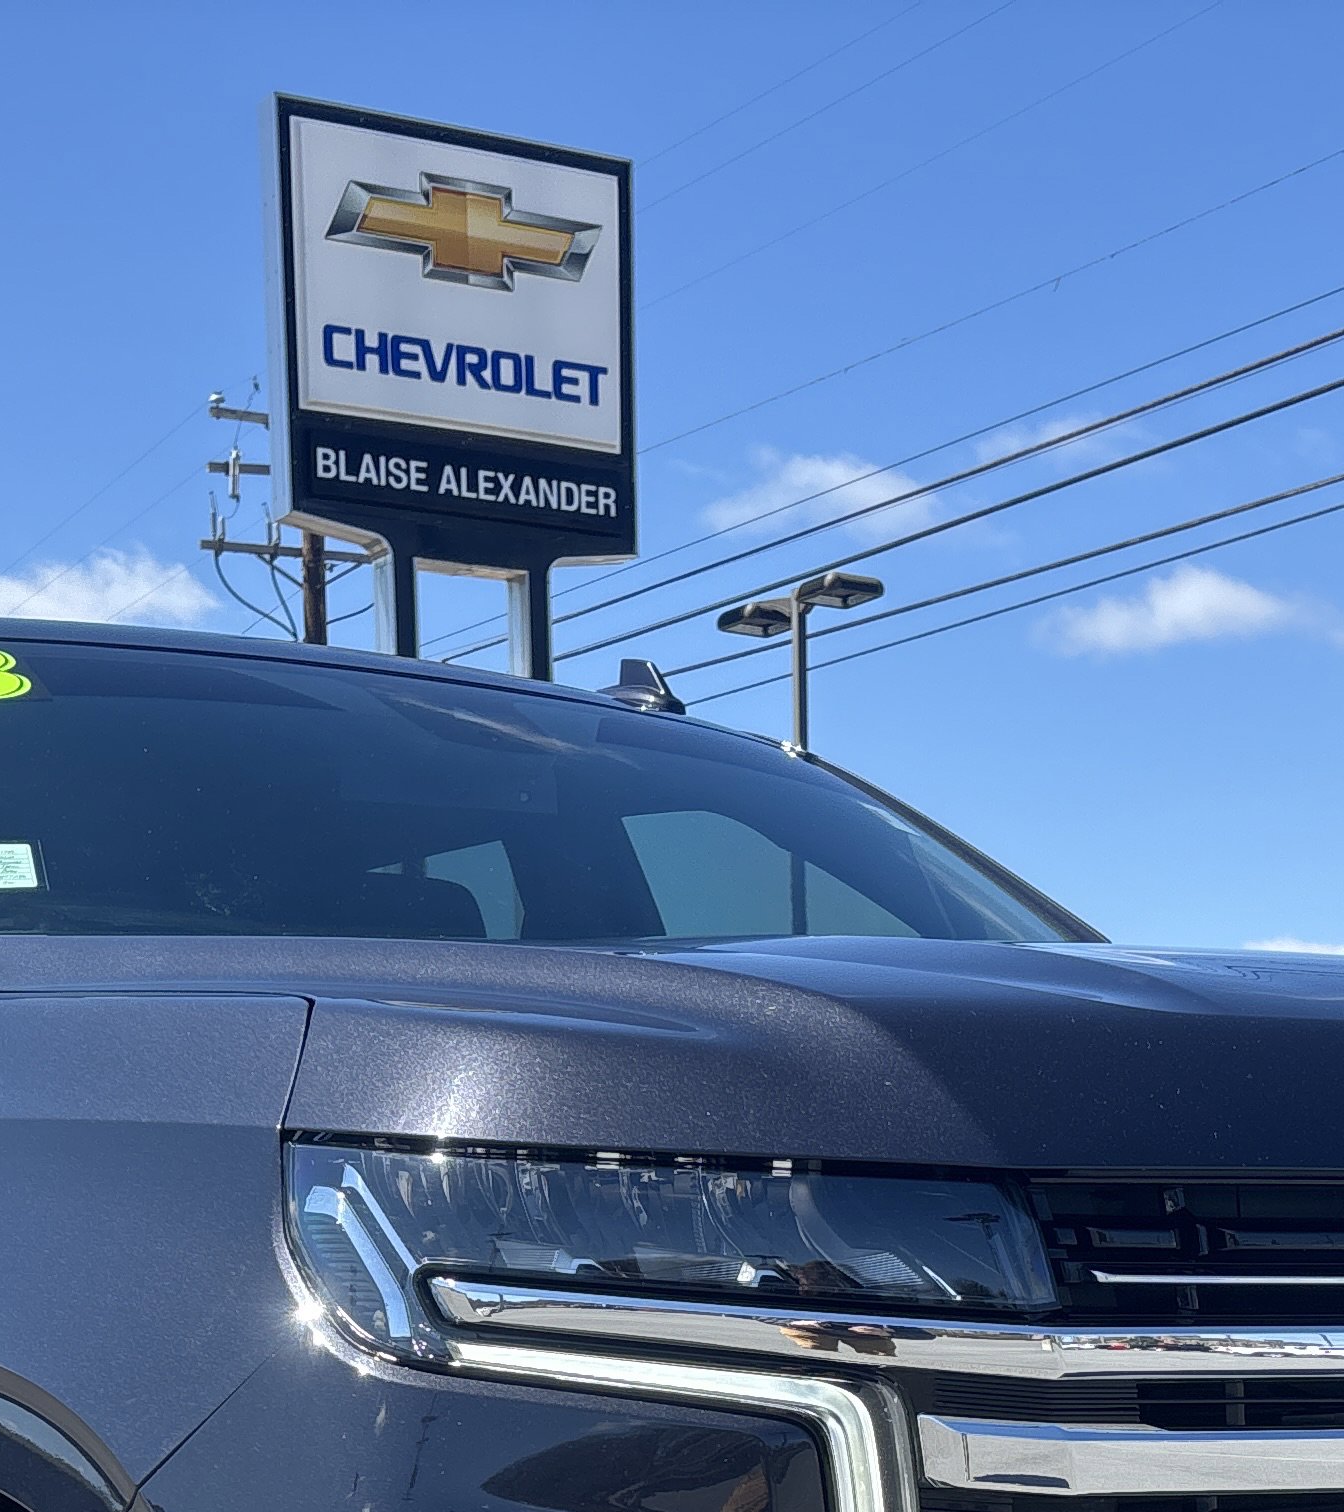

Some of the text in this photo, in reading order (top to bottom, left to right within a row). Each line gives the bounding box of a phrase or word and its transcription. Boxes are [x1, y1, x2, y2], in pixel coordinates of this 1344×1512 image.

[323, 324, 608, 407] CHEVROLET
[316, 446, 617, 518] BLAISE ALEXANDER
